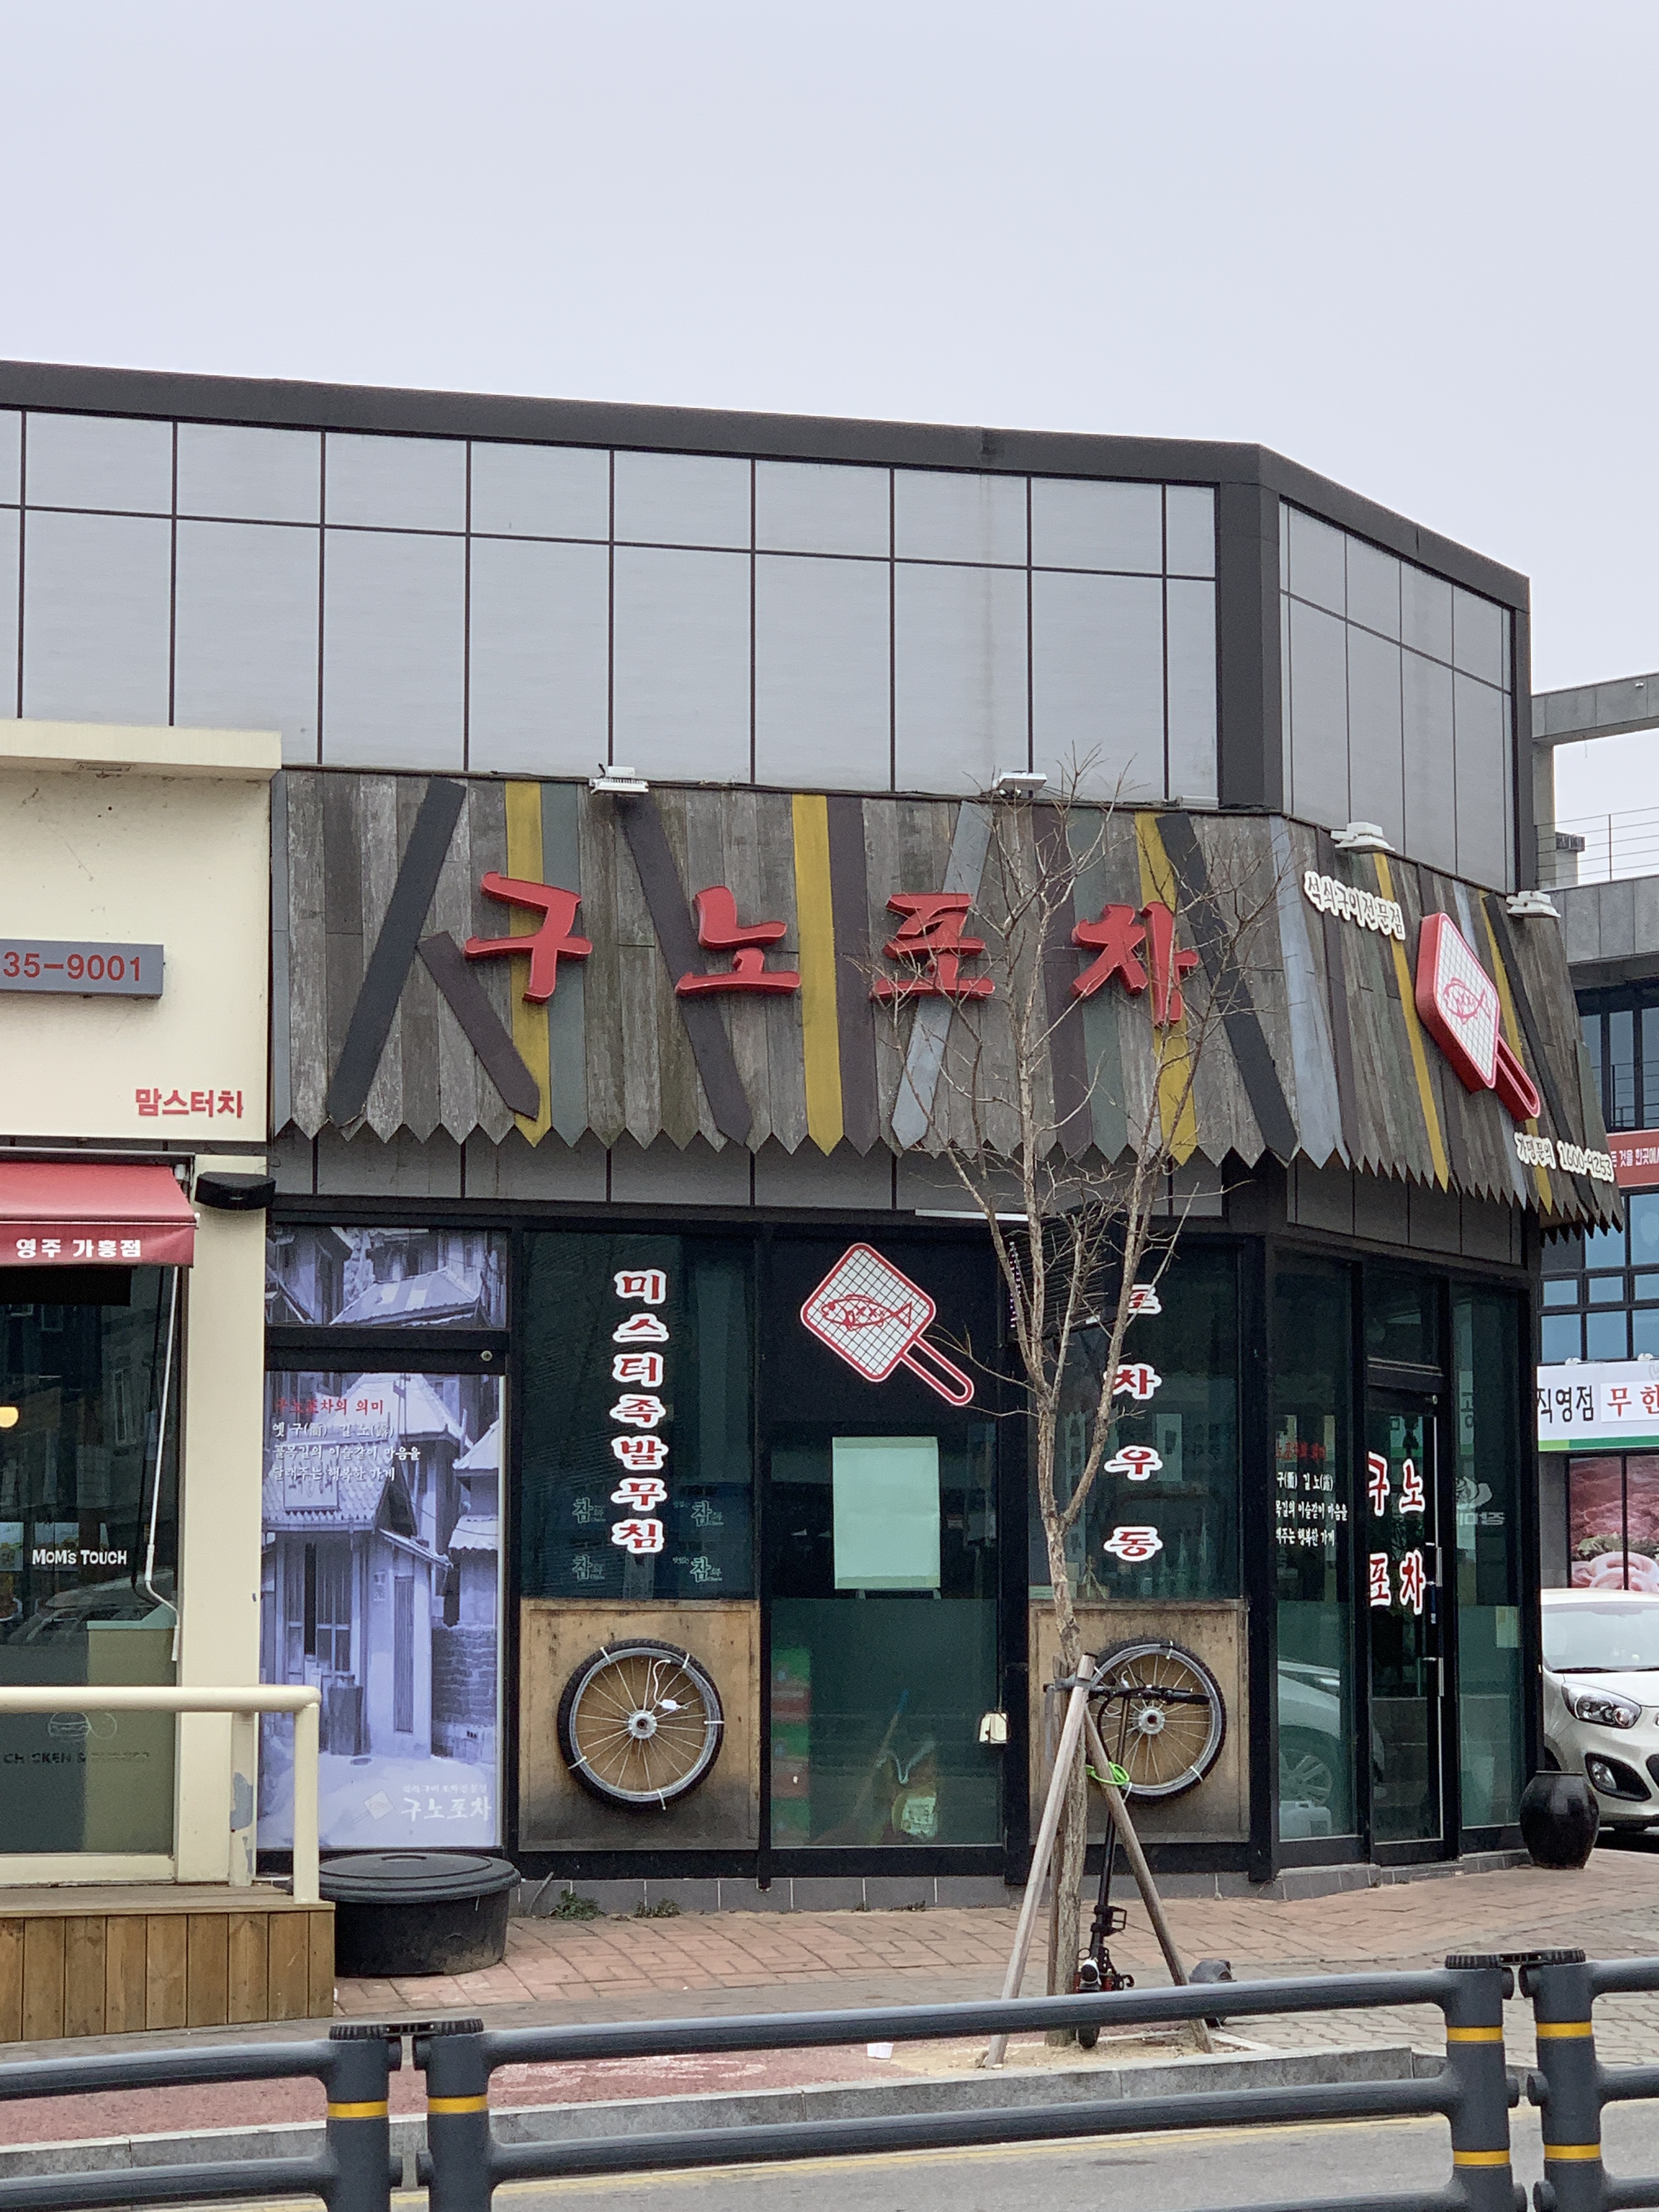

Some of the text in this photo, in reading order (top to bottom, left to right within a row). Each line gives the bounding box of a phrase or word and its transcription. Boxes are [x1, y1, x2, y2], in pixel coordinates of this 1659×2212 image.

[1305, 871, 1405, 939] 석쇠구이전문점
[464, 871, 1199, 1029] 구노포차
[3, 951, 140, 981] 35-9001
[1515, 1132, 1615, 1183] 가맹문의 1600-9253
[16, 1238, 141, 1259] 영주 가흥점
[356, 1399, 383, 1415] 의미
[385, 1446, 421, 1460] 마음을
[328, 1467, 366, 1481] 행복한
[371, 1467, 395, 1481] 가게
[1369, 1451, 1425, 1516] 구노
[1276, 1500, 1295, 1519] 목길의
[80, 1549, 127, 1565] TOUCH
[1370, 1550, 1426, 1615] 포차
[3, 1752, 72, 1764] CHCKEN
[400, 1796, 492, 1821] 구노포차
